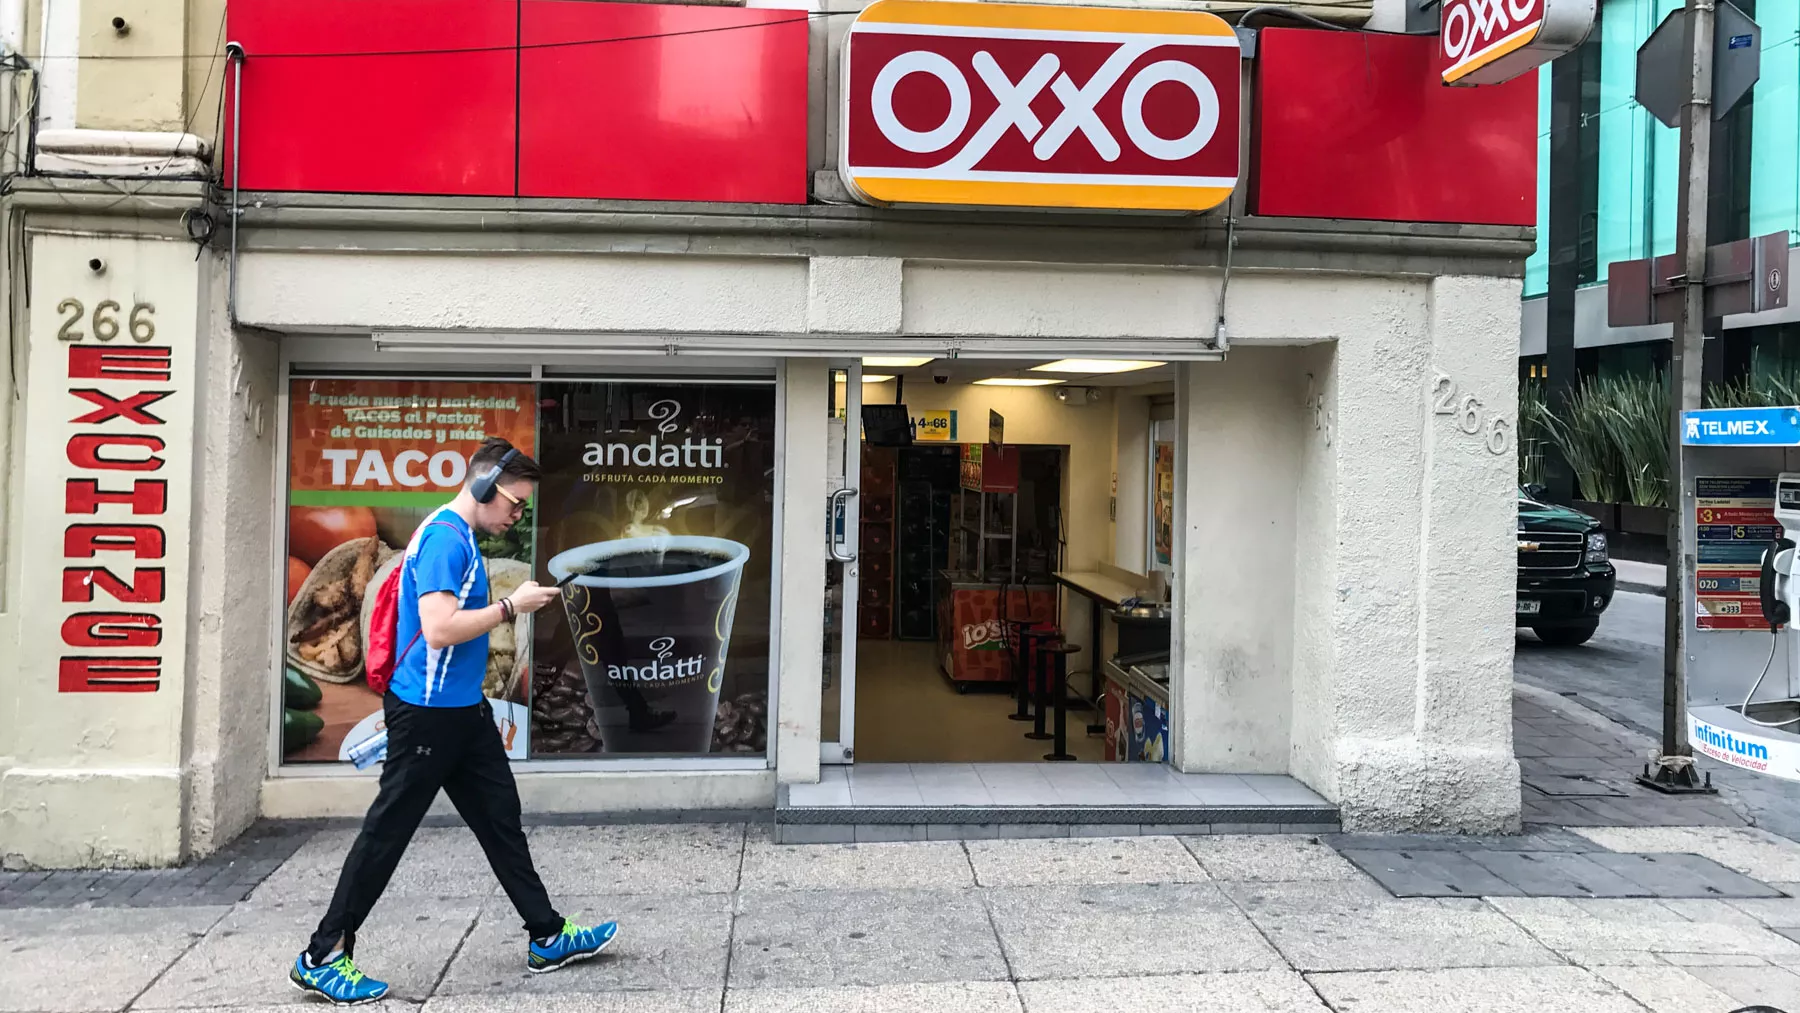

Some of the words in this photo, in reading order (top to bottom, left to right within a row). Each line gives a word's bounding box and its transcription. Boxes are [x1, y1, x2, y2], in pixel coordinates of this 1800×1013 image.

[870, 45, 1220, 168] OXXO
[57, 298, 156, 344] 266
[309, 394, 370, 406] Prueba
[373, 395, 438, 408] nuestra
[440, 396, 521, 412] variedad,
[344, 410, 402, 423] TACOS
[404, 411, 422, 424] al
[426, 411, 486, 427] Pastor,
[1432, 378, 1511, 456] 266
[1701, 420, 1769, 435] TELMEX
[331, 426, 352, 439] de
[355, 426, 433, 440] Guisados
[436, 431, 446, 443] y
[582, 434, 724, 469] andatti
[322, 449, 477, 487] TACO
[583, 474, 634, 484] DISFRUTA
[638, 475, 667, 484] CADA
[670, 475, 724, 485] MOMENTO
[58, 344, 177, 693] EXCHANGE
[1699, 580, 1718, 589] 020
[608, 654, 703, 681] andatti
[1694, 720, 1768, 760] infinitum
[1721, 752, 1730, 762] de
[1731, 754, 1768, 771] Velocidad
